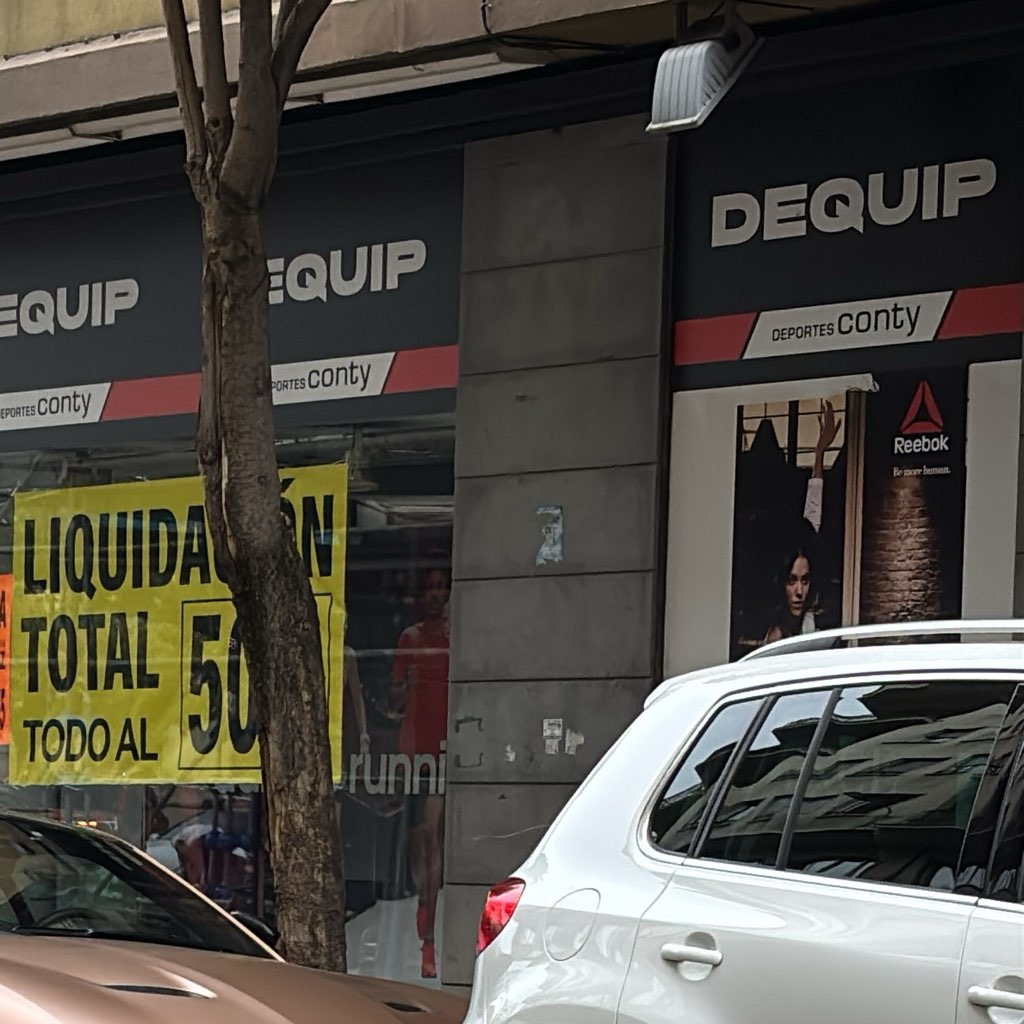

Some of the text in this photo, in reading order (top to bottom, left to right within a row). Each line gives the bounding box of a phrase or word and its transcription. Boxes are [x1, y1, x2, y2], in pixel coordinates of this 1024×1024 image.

[711, 158, 997, 248] DEQUIP
[267, 239, 427, 305] EQUIP
[772, 302, 921, 342] DEPORTES conty
[271, 361, 372, 392] PORTES conty
[37, 391, 92, 418] conty
[894, 434, 949, 454] Reebok
[893, 466, 904, 477] Be
[23, 478, 335, 600] LIQUIDAN
[20, 611, 160, 693] TOTAL
[23, 717, 159, 763] TODO AL
